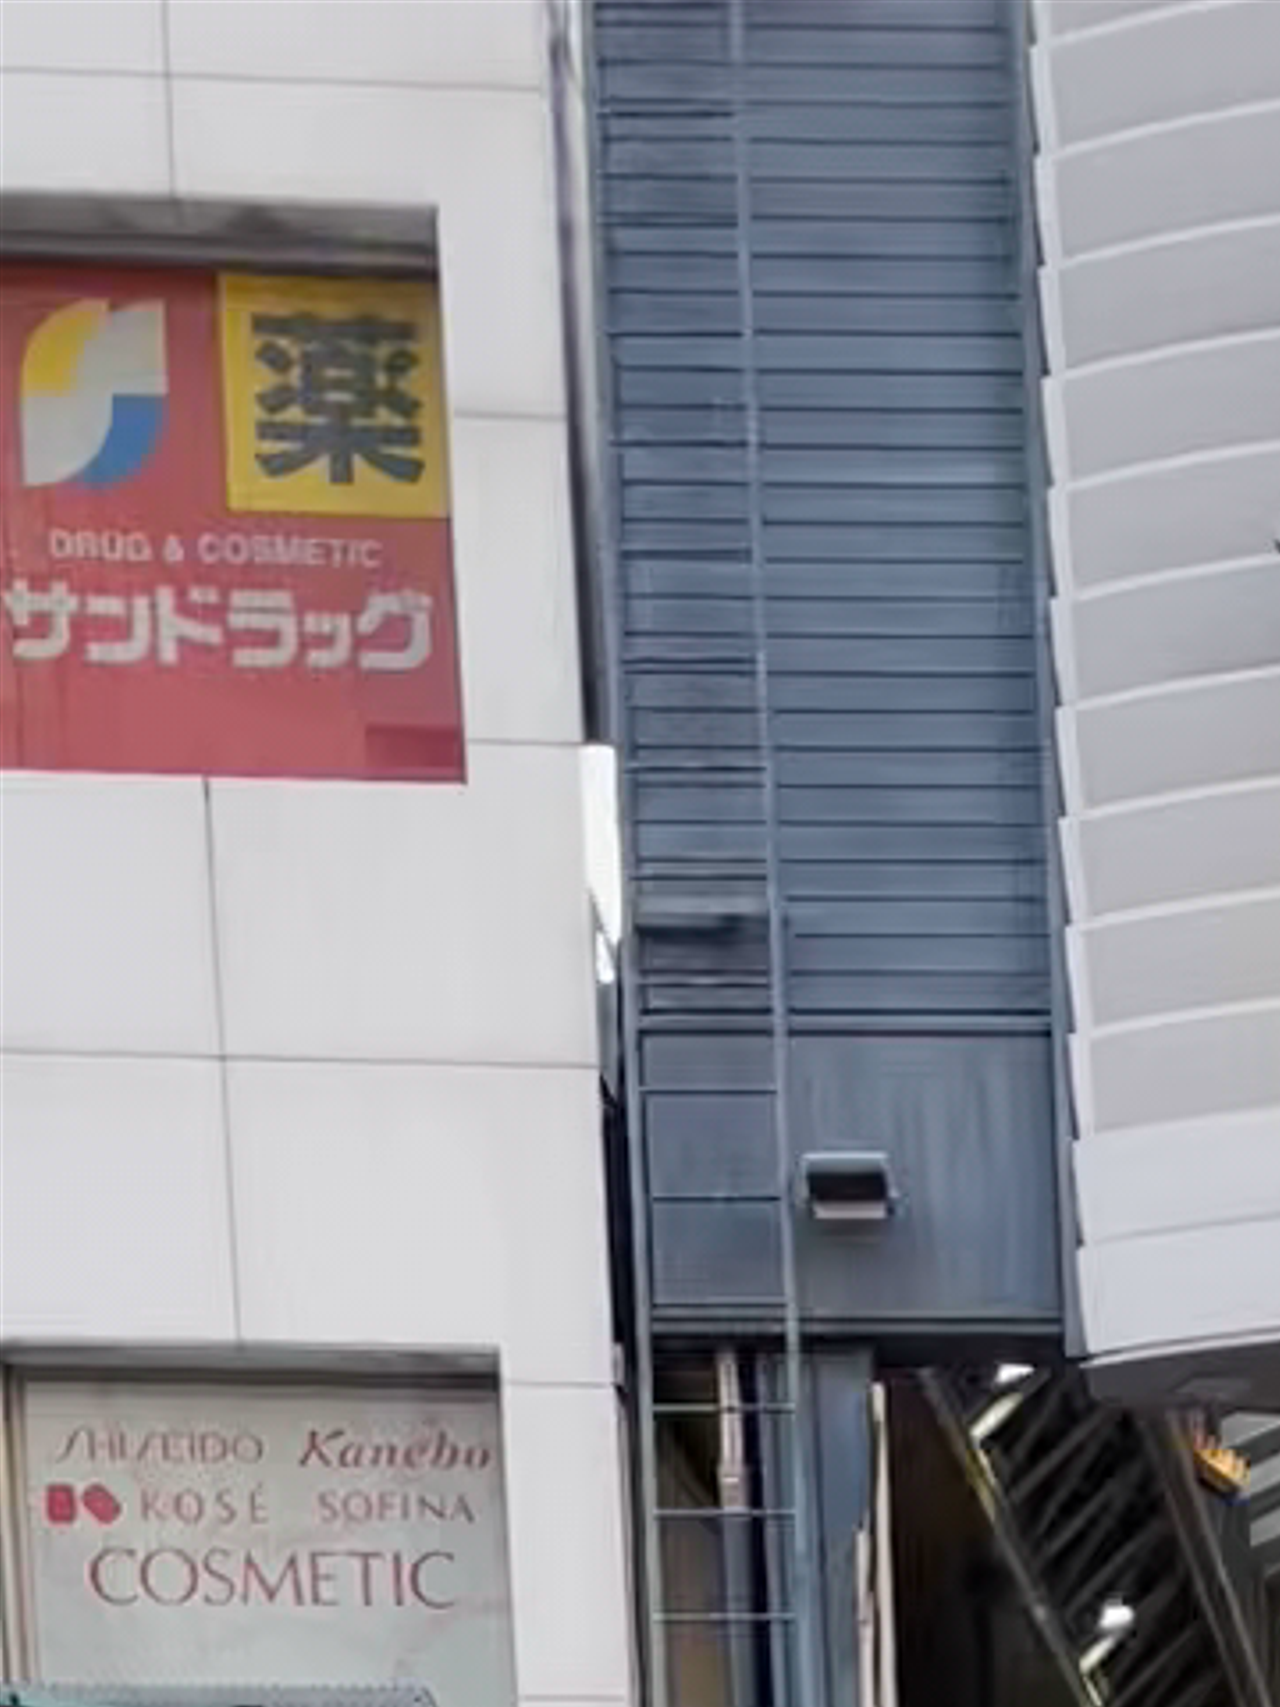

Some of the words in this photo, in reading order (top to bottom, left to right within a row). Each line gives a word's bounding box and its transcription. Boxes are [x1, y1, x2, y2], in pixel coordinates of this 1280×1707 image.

[251, 310, 426, 486] 薬
[49, 529, 153, 562] DRUG
[164, 533, 183, 564] &
[198, 531, 384, 568] COSMETIC
[2, 577, 433, 672] サンドラッグ
[54, 1427, 267, 1467] SHISEIDO
[299, 1428, 495, 1472] Kanebo
[316, 1487, 477, 1524] SOFINA
[88, 1546, 458, 1611] COSMETIC
